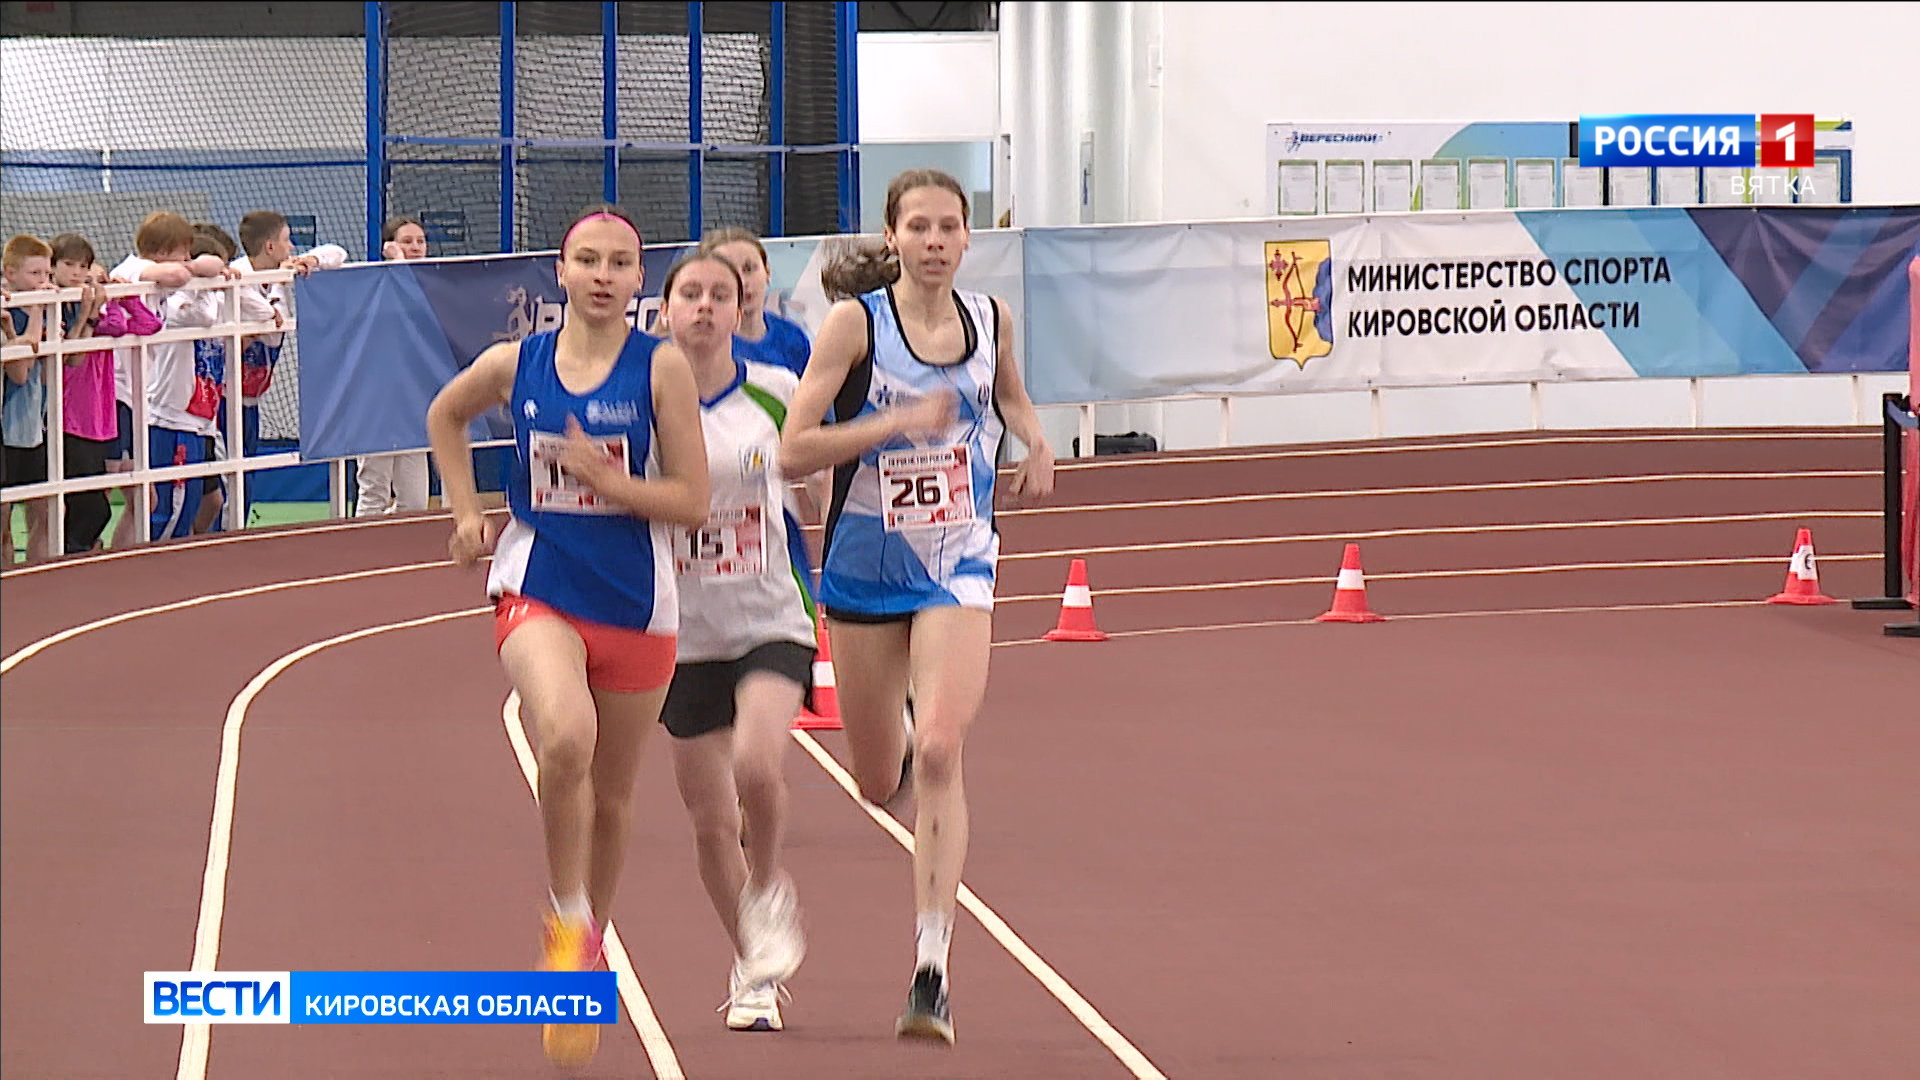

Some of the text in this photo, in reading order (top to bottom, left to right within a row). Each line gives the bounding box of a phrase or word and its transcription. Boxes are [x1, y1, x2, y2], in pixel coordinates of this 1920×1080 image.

[1347, 256, 1672, 293] МИНИСТЕРСТВО СПОРТА
[1347, 299, 1640, 338] КИРОВСКОЙ ОБЛАСТИ
[890, 475, 941, 509] 26
[685, 527, 724, 559] 15
